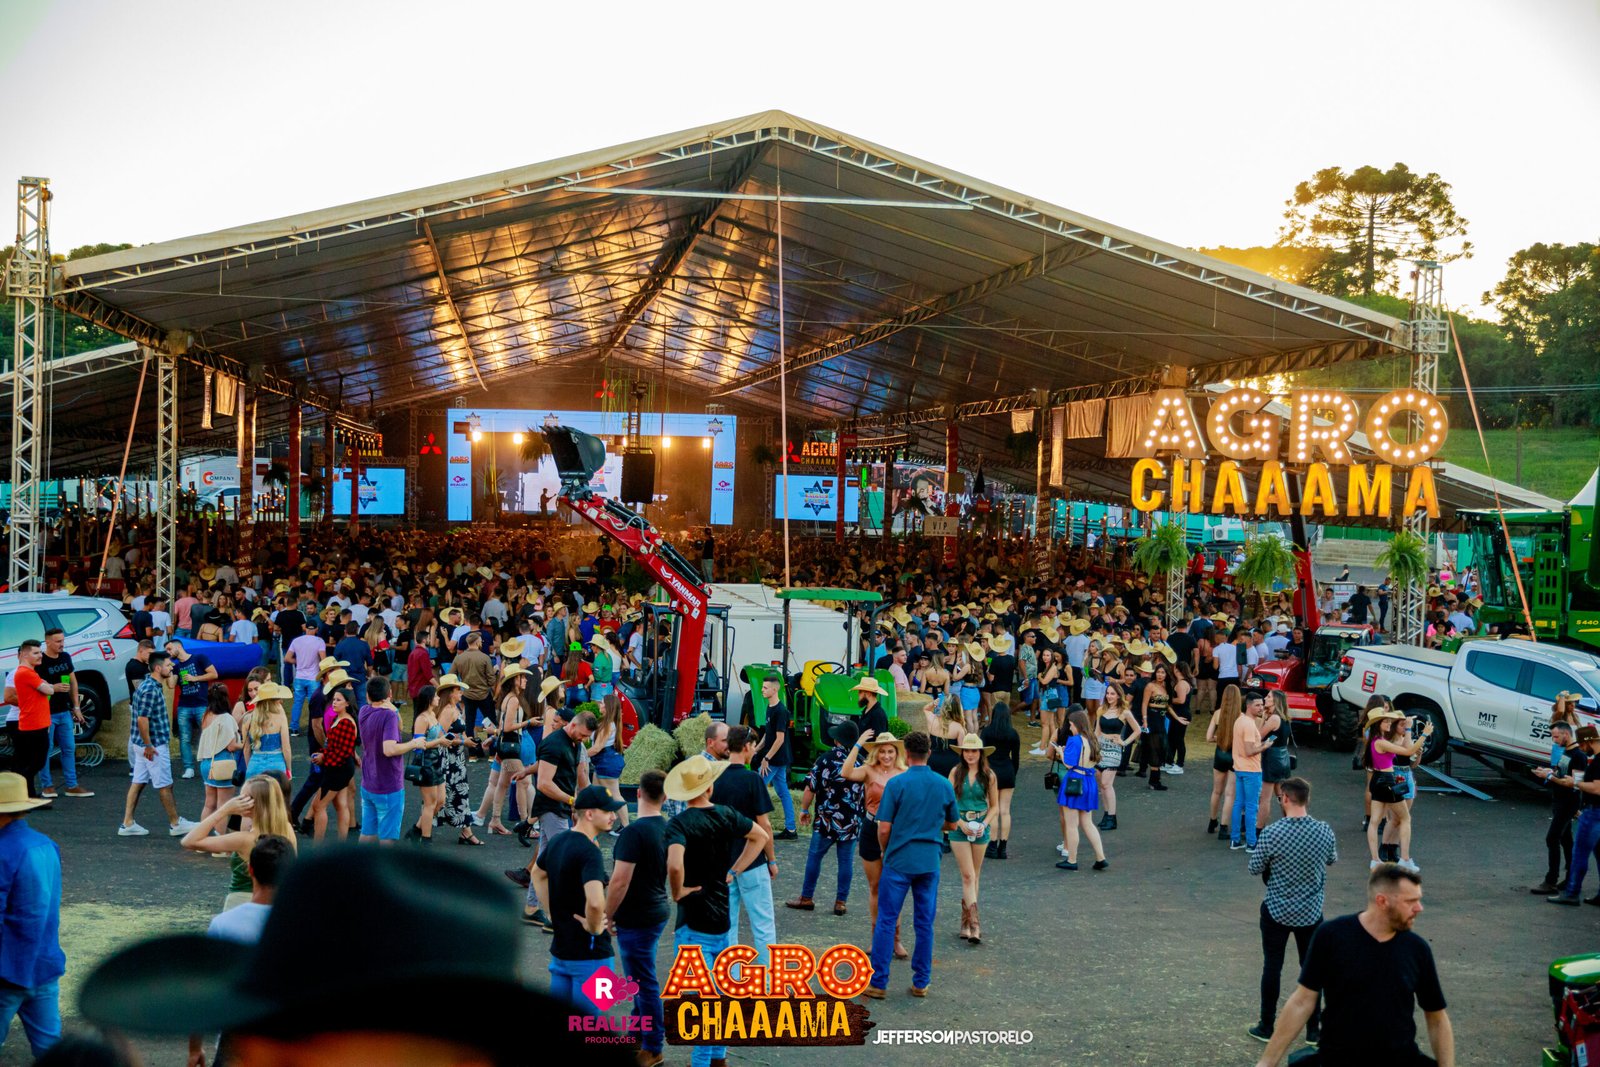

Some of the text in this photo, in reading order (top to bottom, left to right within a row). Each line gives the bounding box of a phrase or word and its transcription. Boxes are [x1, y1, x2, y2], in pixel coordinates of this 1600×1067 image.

[1130, 388, 1448, 465] AGRO
[347, 448, 383, 457] CAAMA
[801, 441, 838, 457] AGRO
[801, 457, 836, 465] CHAAAMA
[1131, 458, 1441, 518] CHAAAMA
[668, 576, 701, 608] YANMAR
[48, 662, 69, 675] BOSS
[1364, 673, 1375, 687] 5
[1479, 711, 1498, 722] MIT
[1477, 720, 1497, 730] DRIVE
[1531, 720, 1550, 730] L20
